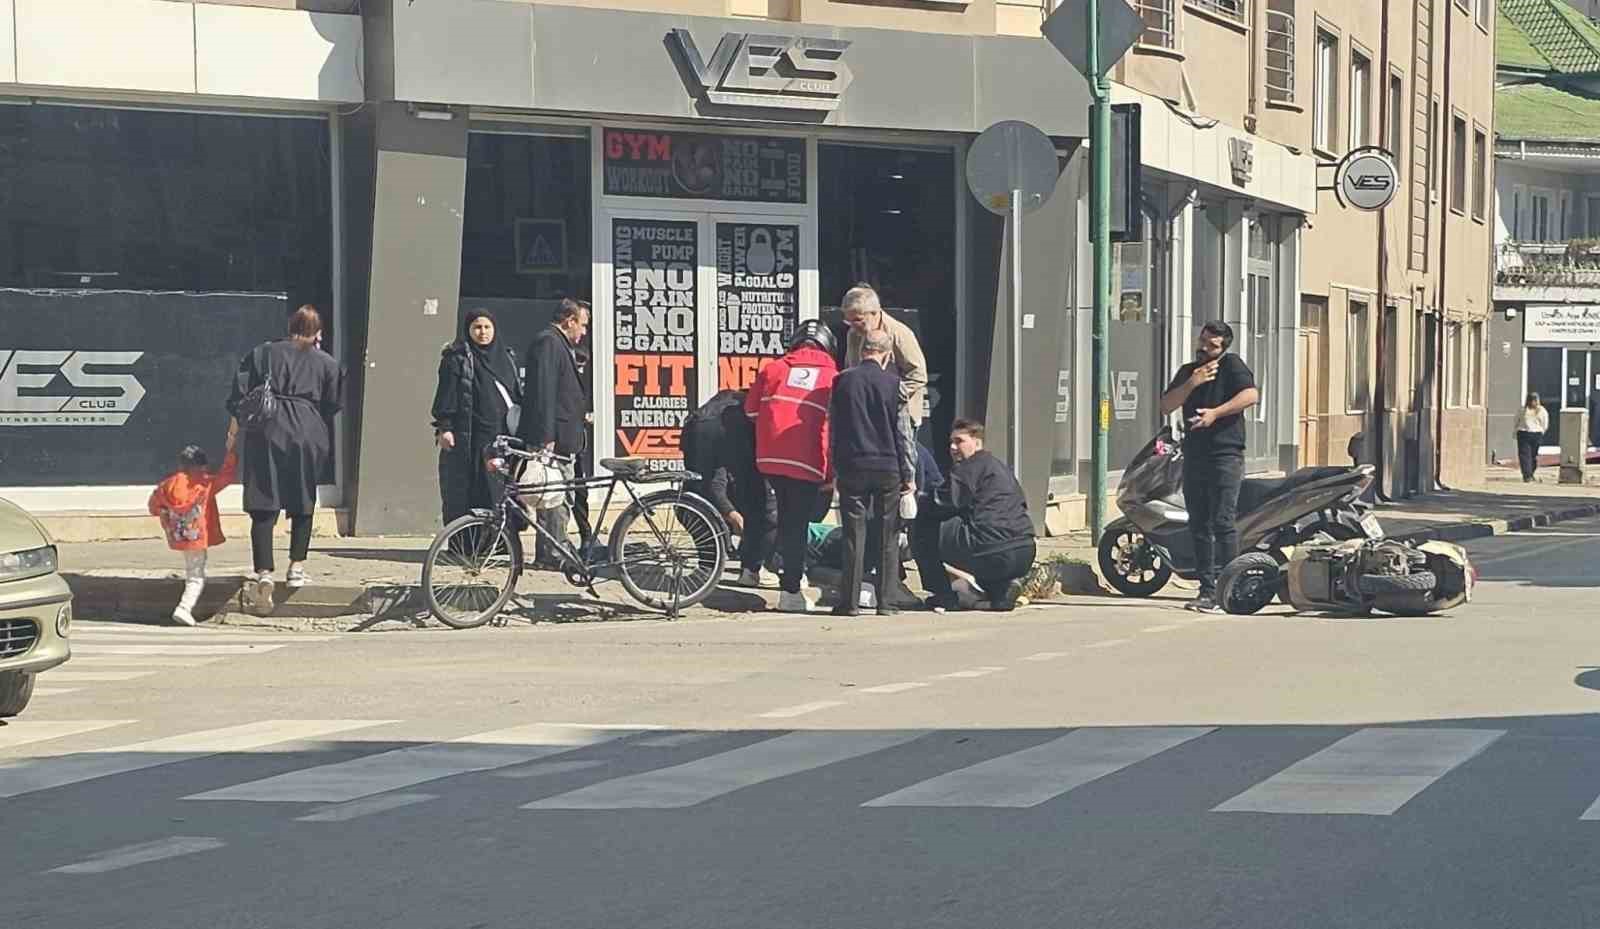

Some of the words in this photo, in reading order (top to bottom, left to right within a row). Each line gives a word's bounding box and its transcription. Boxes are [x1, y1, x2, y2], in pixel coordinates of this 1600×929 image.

[663, 28, 854, 98] VES
[606, 132, 672, 161] GYM
[607, 166, 670, 193] WORKOUT
[1347, 174, 1390, 190] VES
[632, 226, 694, 242] MUSCLE
[651, 244, 694, 261] PUMP
[717, 238, 732, 287] WEIGHT
[734, 227, 746, 287] POWER
[776, 229, 795, 288] GYM
[615, 226, 633, 306] MOVING
[633, 261, 694, 290] NO
[746, 275, 777, 289] GOAL
[634, 290, 694, 307] PAIN
[741, 303, 776, 315] PROTEIN
[615, 311, 633, 351] GET
[633, 307, 694, 336] NO
[740, 314, 784, 332] FOOD
[634, 335, 694, 352] GAIN
[719, 332, 785, 354] BCAA
[615, 354, 694, 396] FIT
[79, 399, 117, 409] CLUB
[633, 396, 688, 409] CALORIES
[1110, 370, 1139, 412] VES
[620, 410, 689, 427] ENERGY
[616, 429, 682, 455] VES
